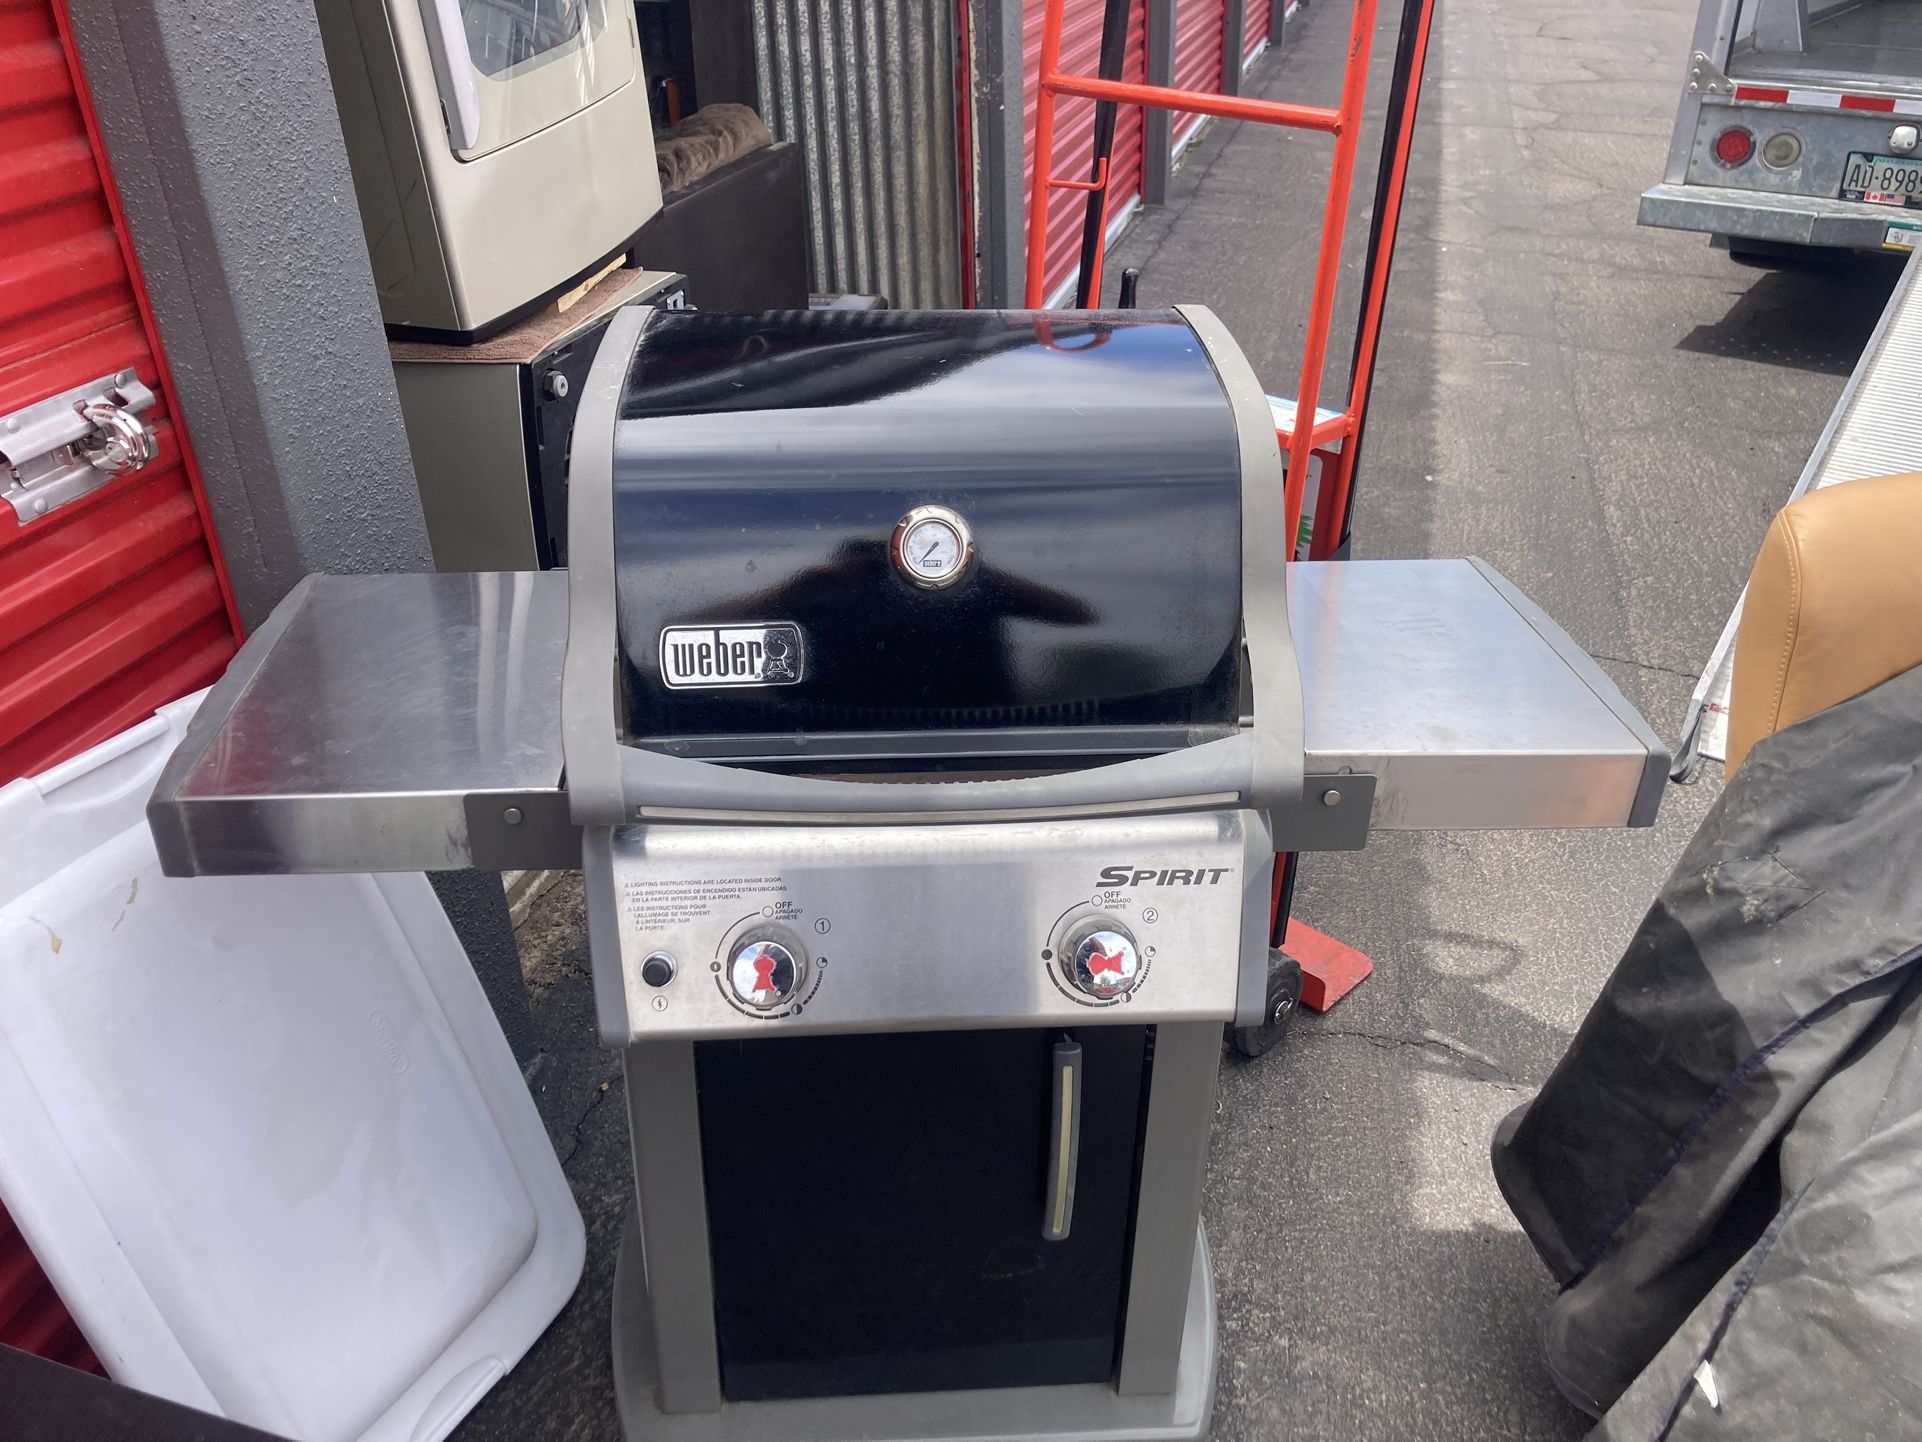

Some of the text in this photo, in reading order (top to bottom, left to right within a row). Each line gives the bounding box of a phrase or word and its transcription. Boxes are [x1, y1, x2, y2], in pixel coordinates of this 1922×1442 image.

[671, 629, 763, 677] weber
[1095, 866, 1229, 888] SPIRIT
[1103, 890, 1122, 899] OFF
[774, 901, 793, 909] OFF
